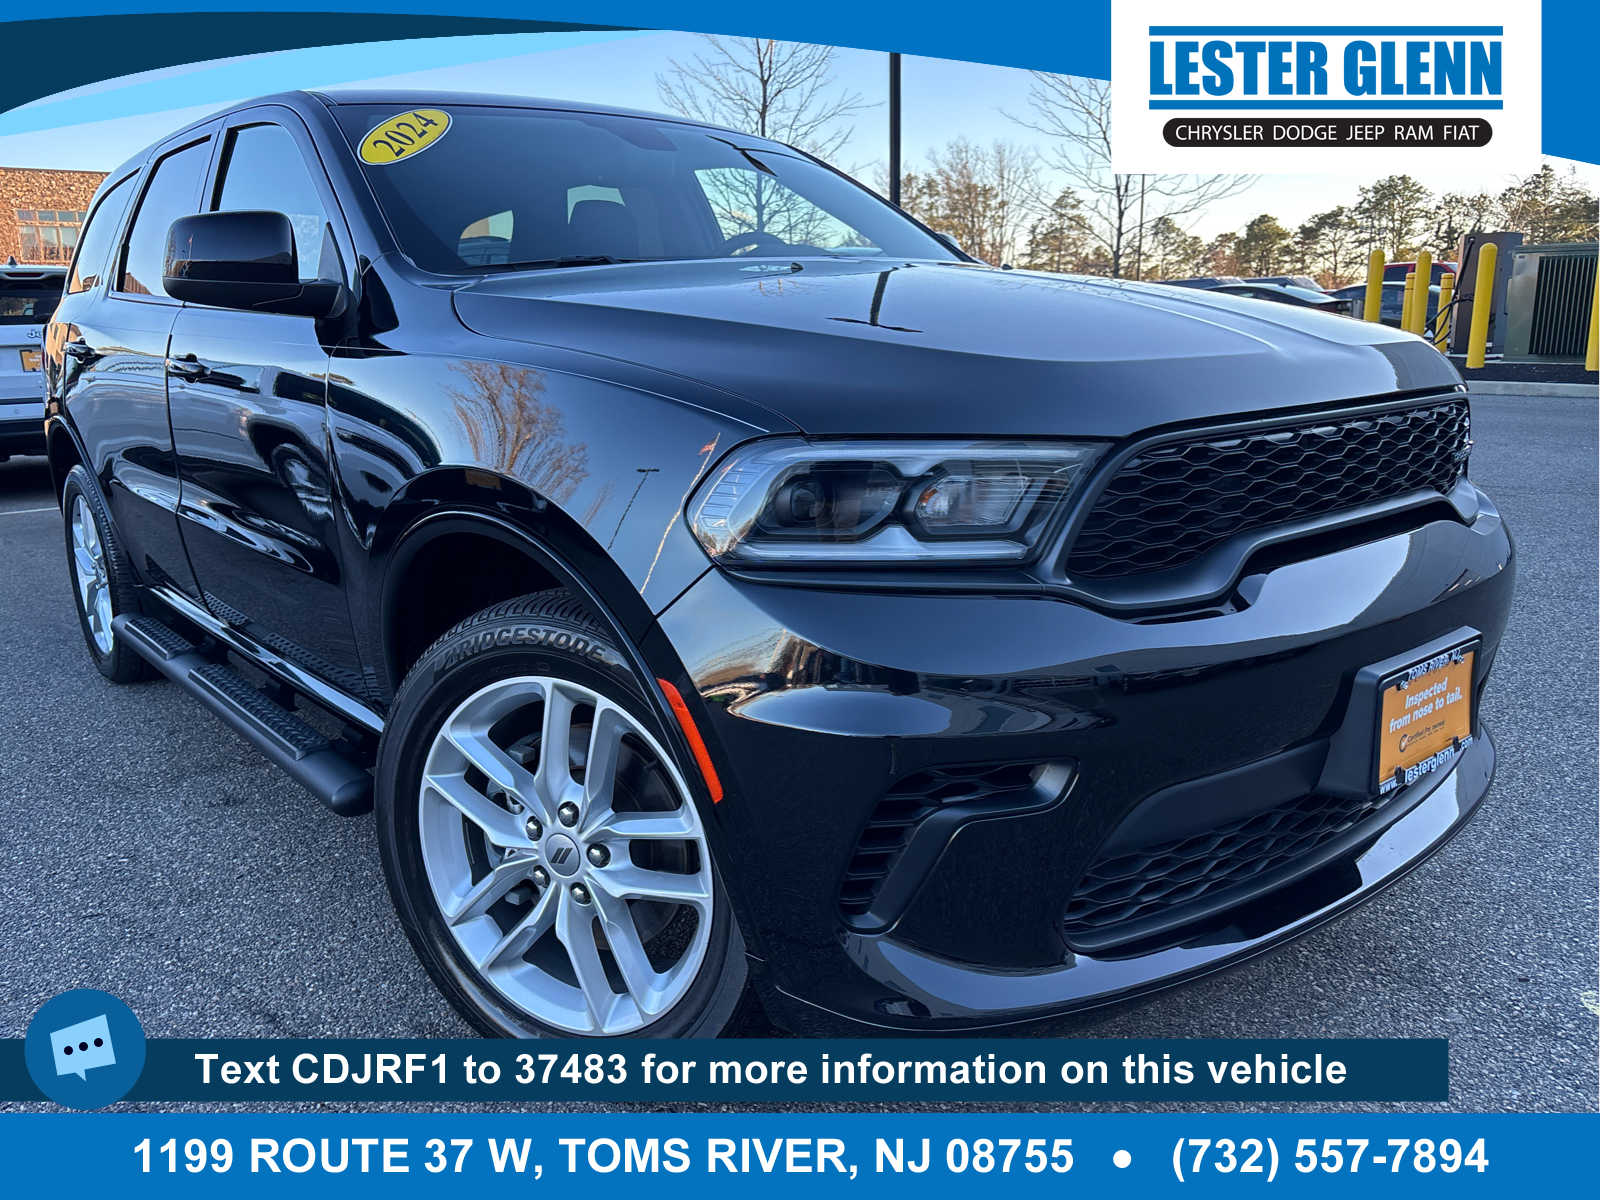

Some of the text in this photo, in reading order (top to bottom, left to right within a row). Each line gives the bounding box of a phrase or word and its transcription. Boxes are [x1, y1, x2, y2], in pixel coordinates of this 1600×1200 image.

[373, 112, 438, 157] 2024
[437, 627, 606, 671] BRIDGESTONE
[1405, 677, 1448, 709] Inspected
[1389, 711, 1411, 734] from
[1412, 702, 1433, 721] nose
[1435, 697, 1445, 711] to
[1405, 748, 1455, 783] lesterglenn
